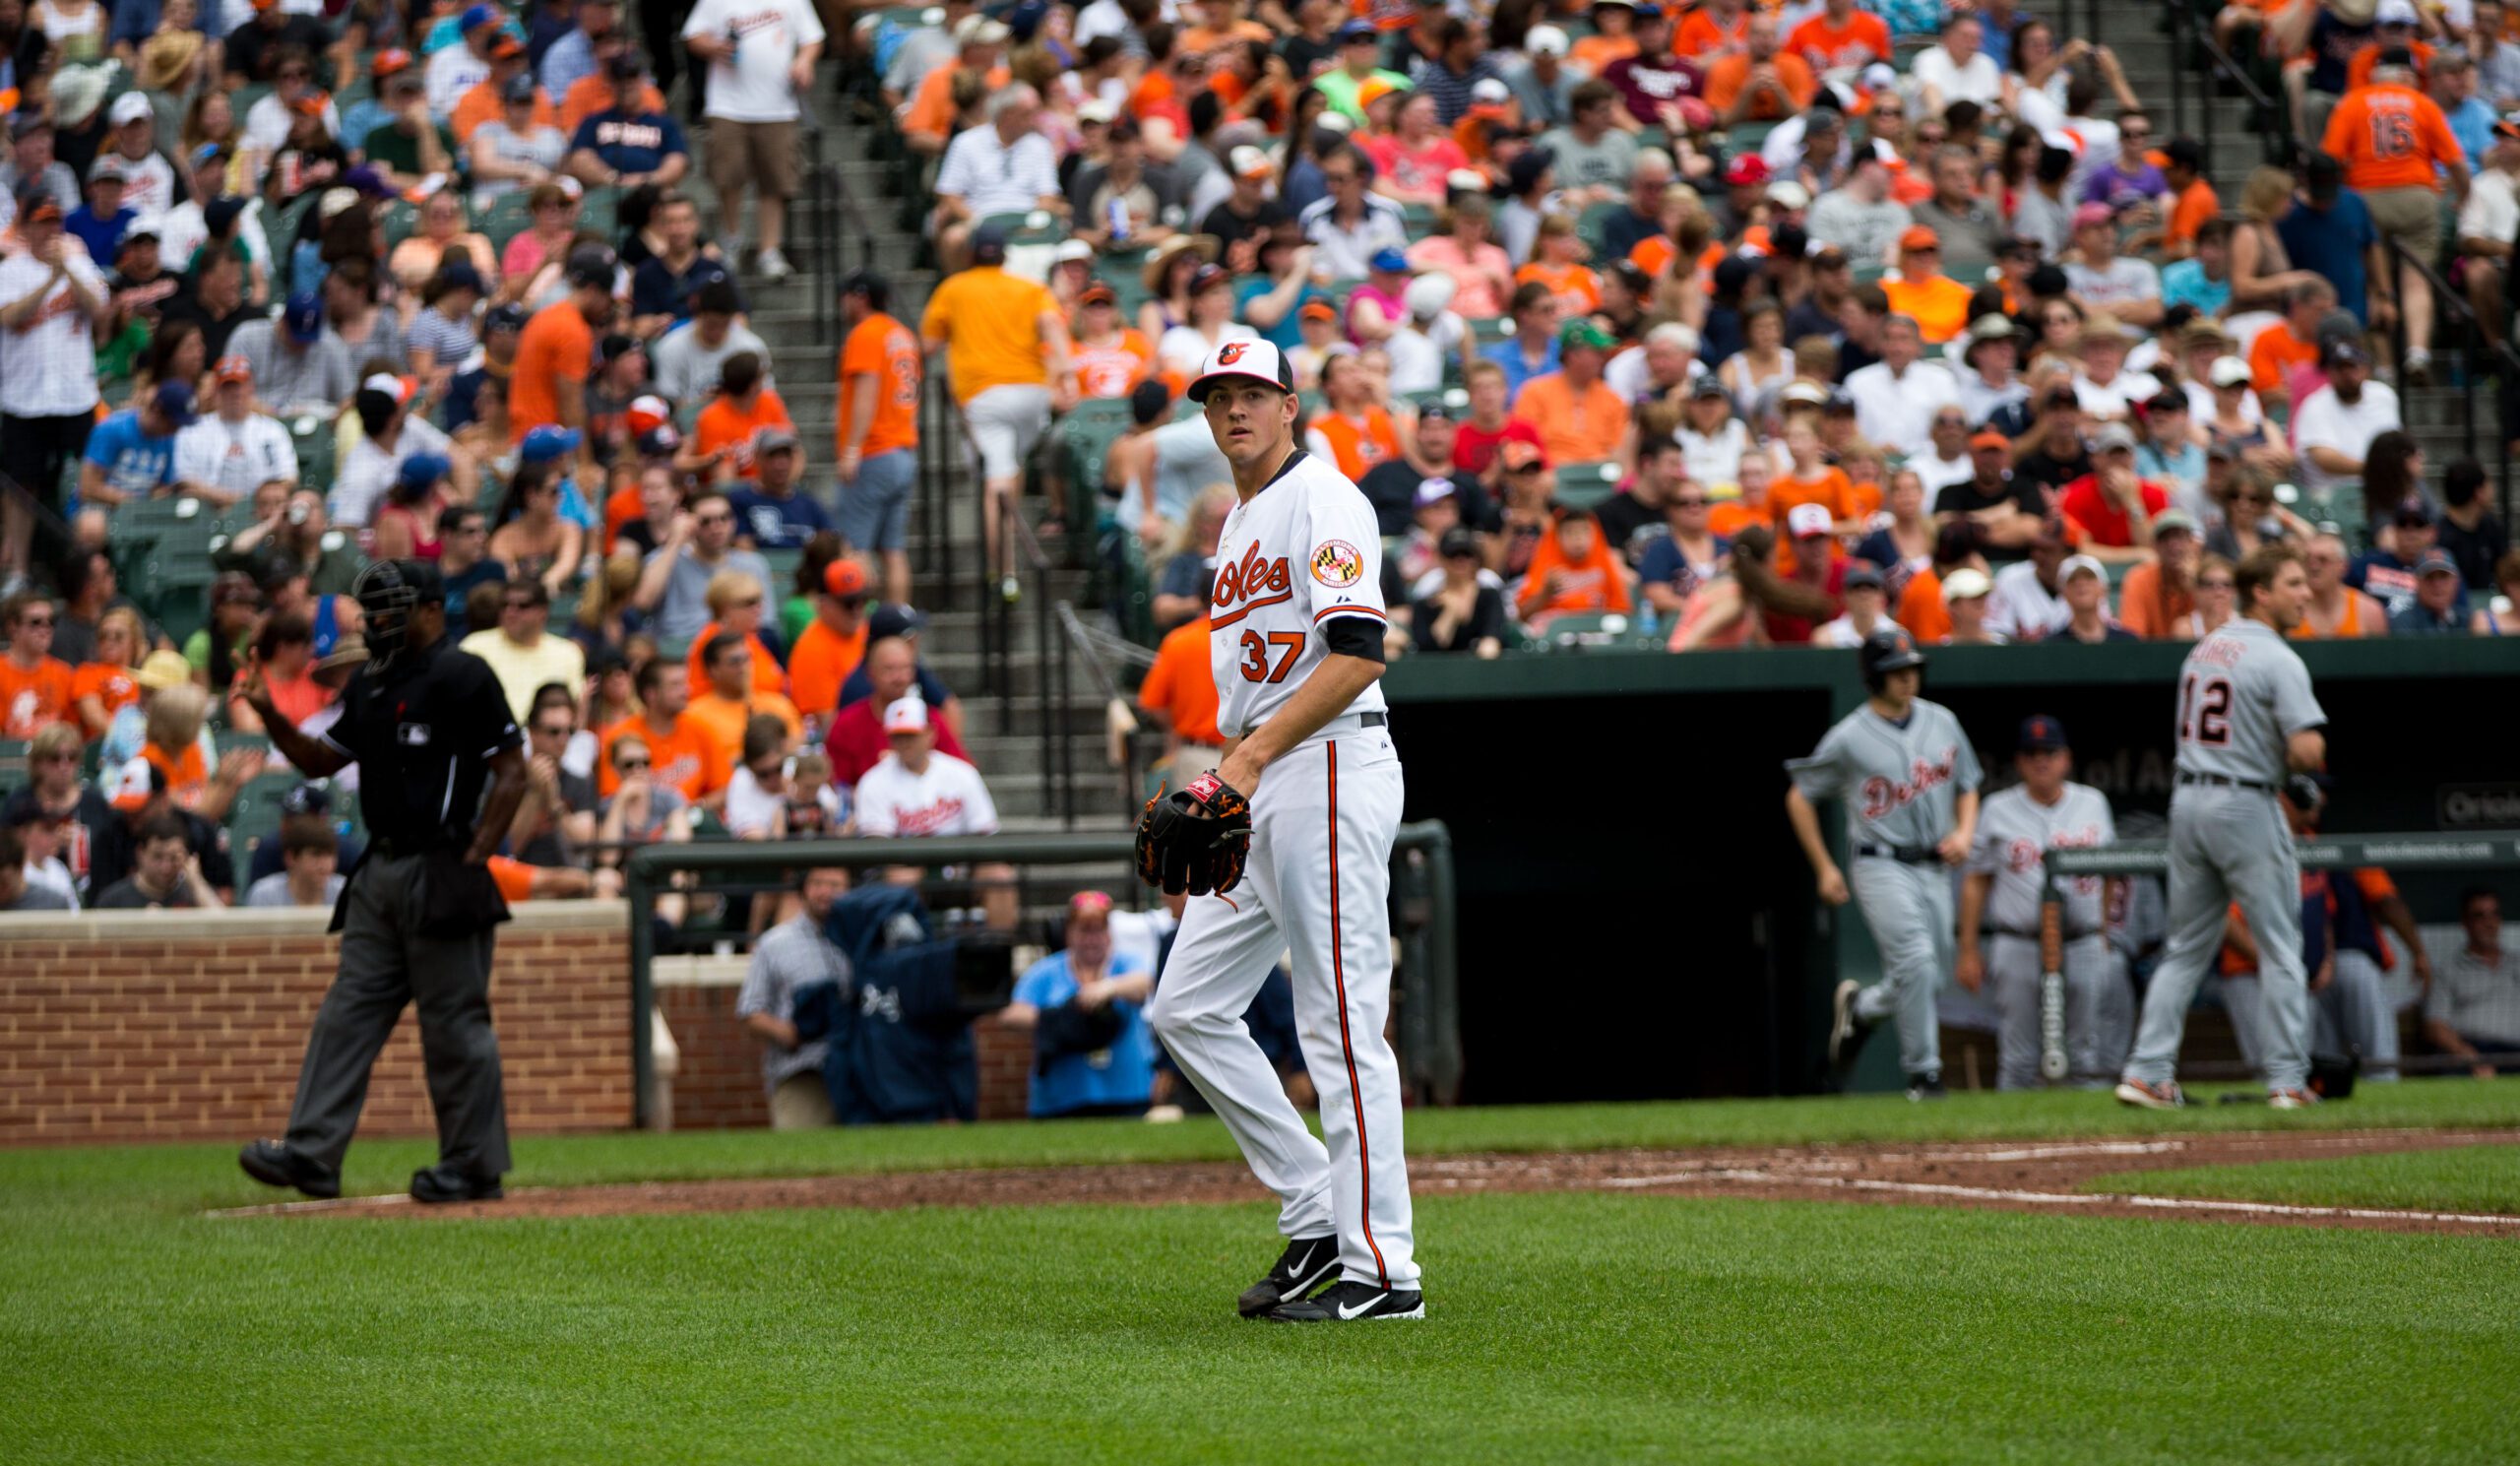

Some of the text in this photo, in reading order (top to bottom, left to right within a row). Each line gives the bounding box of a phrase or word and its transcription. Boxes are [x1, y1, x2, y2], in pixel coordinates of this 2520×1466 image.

[1212, 540, 1292, 607] oles
[1312, 540, 1359, 561] BALTIMORE
[1322, 575, 1359, 588] ORIOLES
[1240, 629, 1306, 683] 37
[2179, 672, 2233, 747] 12
